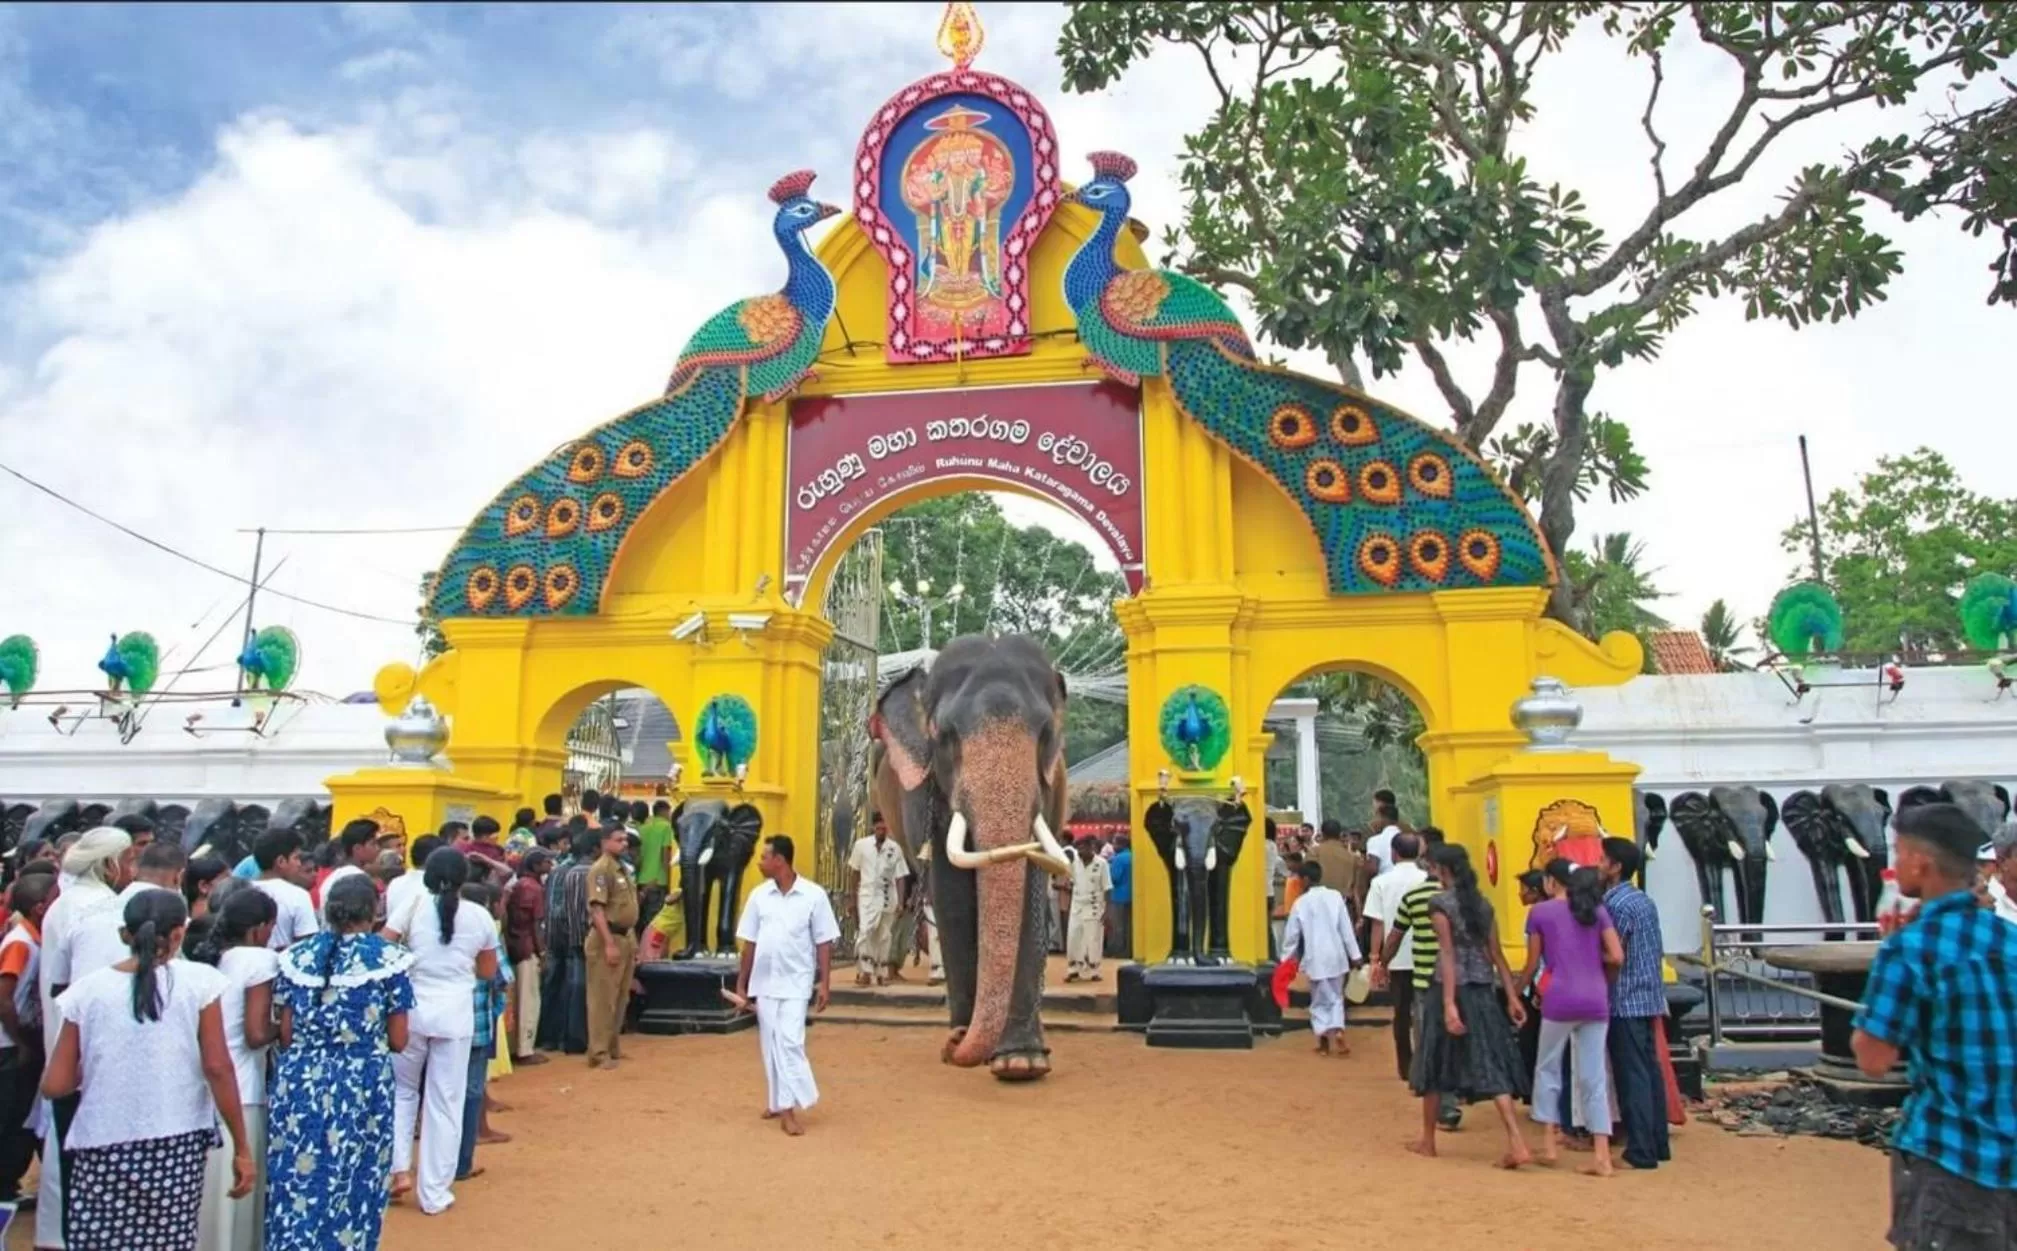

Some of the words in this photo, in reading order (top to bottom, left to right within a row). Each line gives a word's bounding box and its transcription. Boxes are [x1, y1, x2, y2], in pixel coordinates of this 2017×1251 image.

[867, 427, 917, 459] මහා
[926, 413, 1031, 444] කතරගම
[1037, 431, 1131, 496] දේවාලය
[935, 455, 984, 470] Ruhunu
[987, 457, 1021, 474] Maha
[1024, 466, 1095, 512] Kataragama
